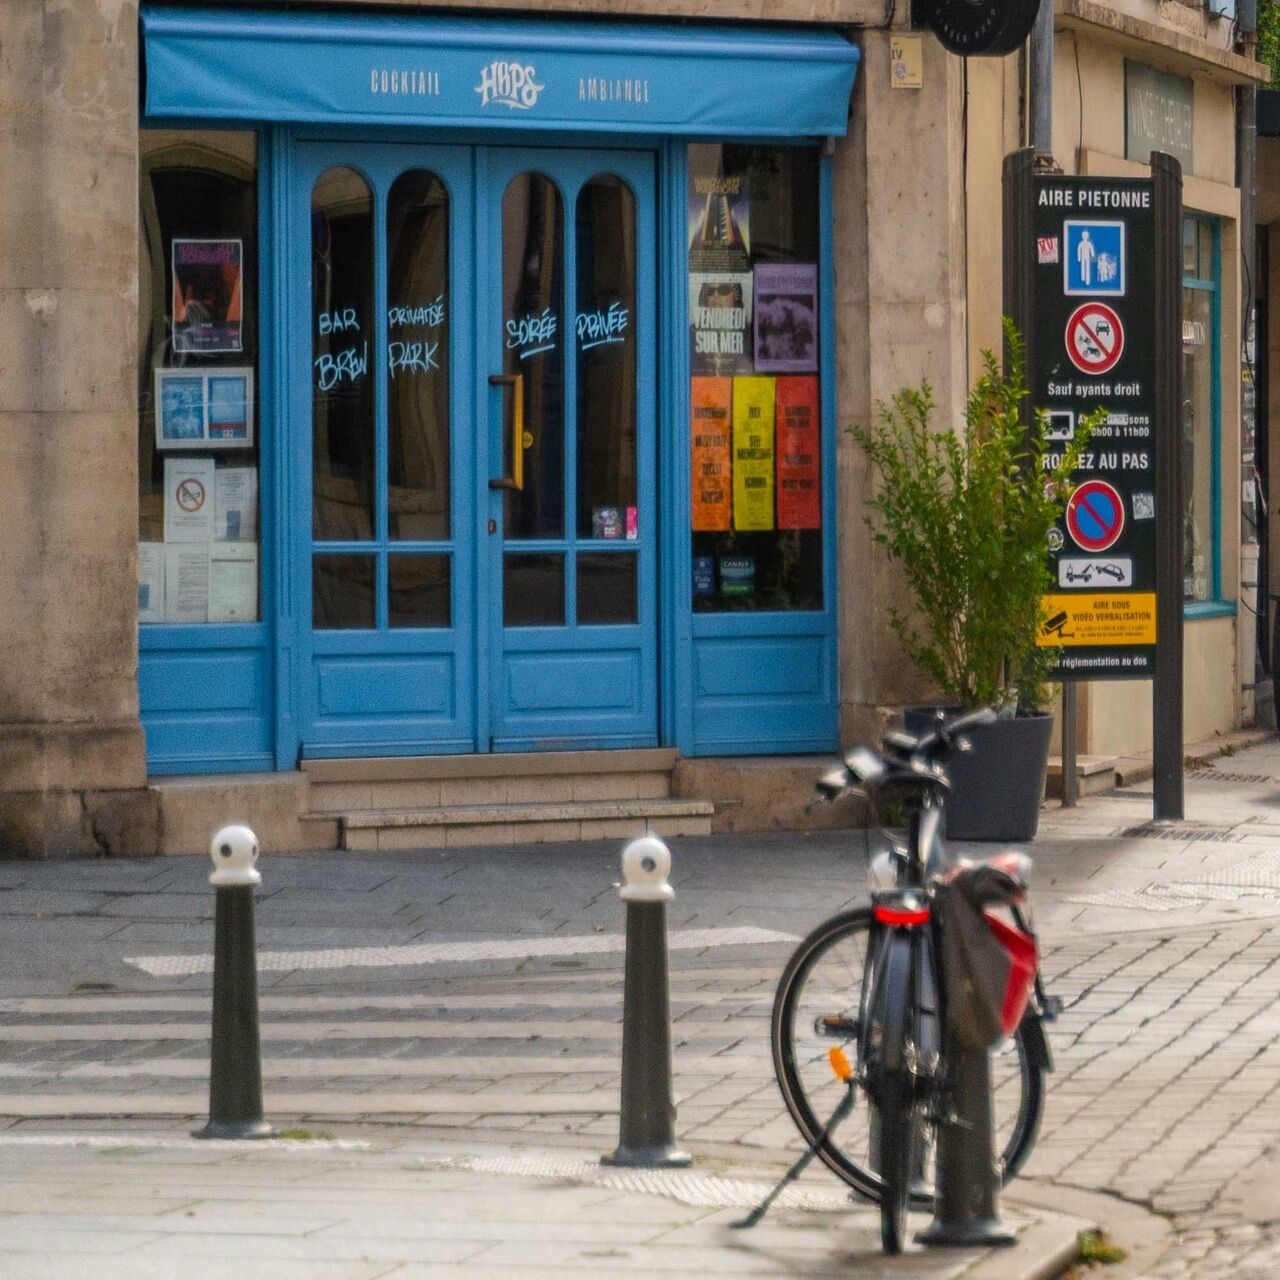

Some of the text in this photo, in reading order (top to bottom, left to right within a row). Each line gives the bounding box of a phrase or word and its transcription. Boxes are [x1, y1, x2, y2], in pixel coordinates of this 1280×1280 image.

[370, 69, 441, 96] COCKTAIL
[578, 78, 650, 103] AMBIANCE
[1038, 189, 1150, 208] AIRE PIETONNE
[319, 308, 360, 337] BAR
[505, 301, 629, 349] SOIRÉE PRIVÉE
[695, 307, 747, 329] VENDREDI
[695, 331, 744, 354] SUR MER
[314, 340, 440, 391] BREW PARK
[1047, 383, 1140, 398] Sauf ayants droit
[1115, 426, 1121, 437] à
[1123, 427, 1150, 437] 11h00
[1099, 453, 1118, 469] AU
[1122, 453, 1149, 469] PAS
[1093, 601, 1131, 609] AIRE SOUS
[1096, 611, 1151, 621] VERBALISATION
[1062, 657, 1120, 670] réglementation
[1122, 657, 1132, 666] au
[1133, 656, 1148, 666] dos
